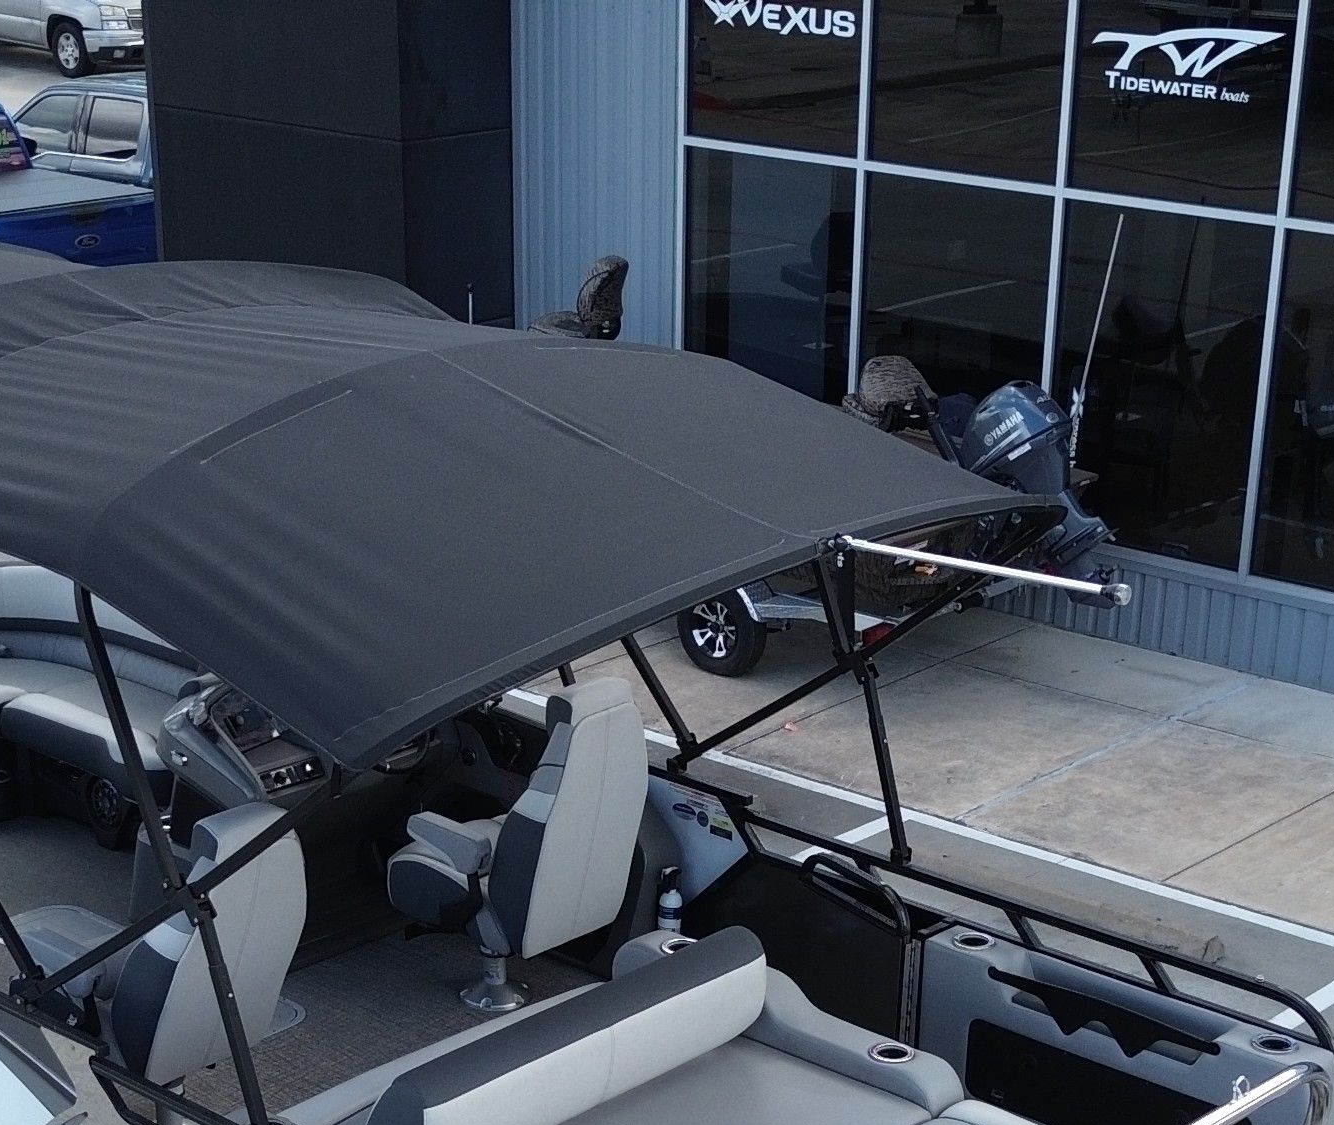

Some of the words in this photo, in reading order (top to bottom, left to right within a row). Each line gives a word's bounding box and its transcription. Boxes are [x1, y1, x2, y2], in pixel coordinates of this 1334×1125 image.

[740, 0, 856, 38] VEXUS
[1220, 87, 1250, 103] boats
[991, 410, 1024, 440] YAMAHA
